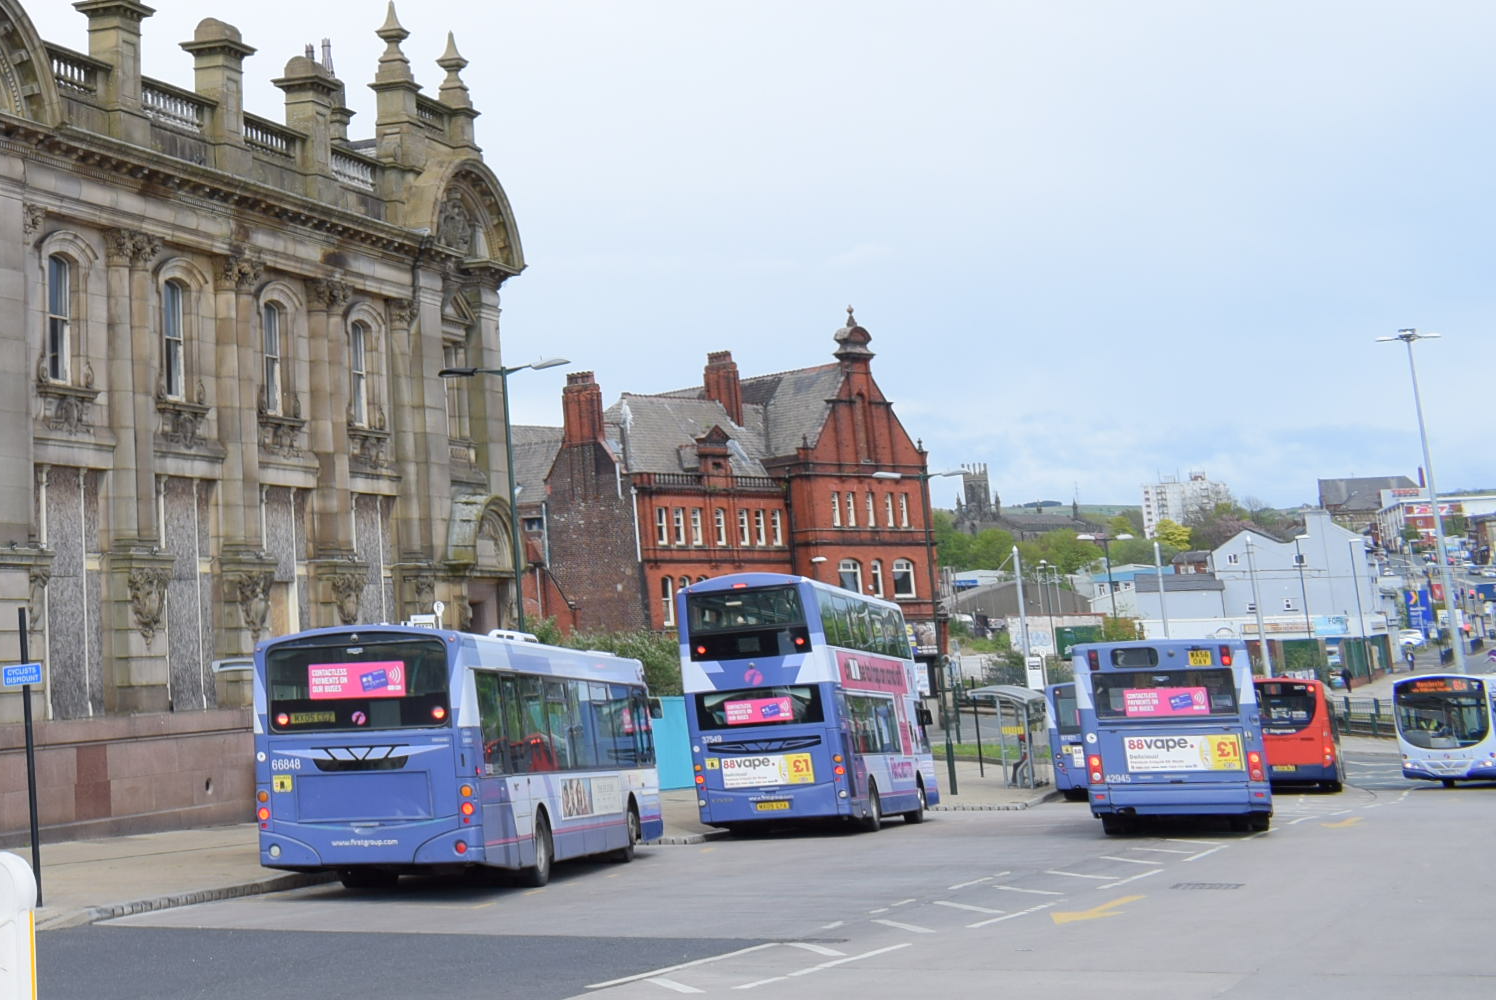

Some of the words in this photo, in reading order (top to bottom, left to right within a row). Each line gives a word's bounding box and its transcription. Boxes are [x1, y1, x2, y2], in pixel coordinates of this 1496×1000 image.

[8, 667, 36, 676] CYCLISTS
[6, 674, 39, 684] DISMOUNT
[1217, 741, 1239, 758] £1
[271, 759, 301, 771] 66848
[792, 759, 811, 773] £1
[1105, 774, 1131, 784] 42945
[331, 838, 399, 848] www.firstgroup.com
